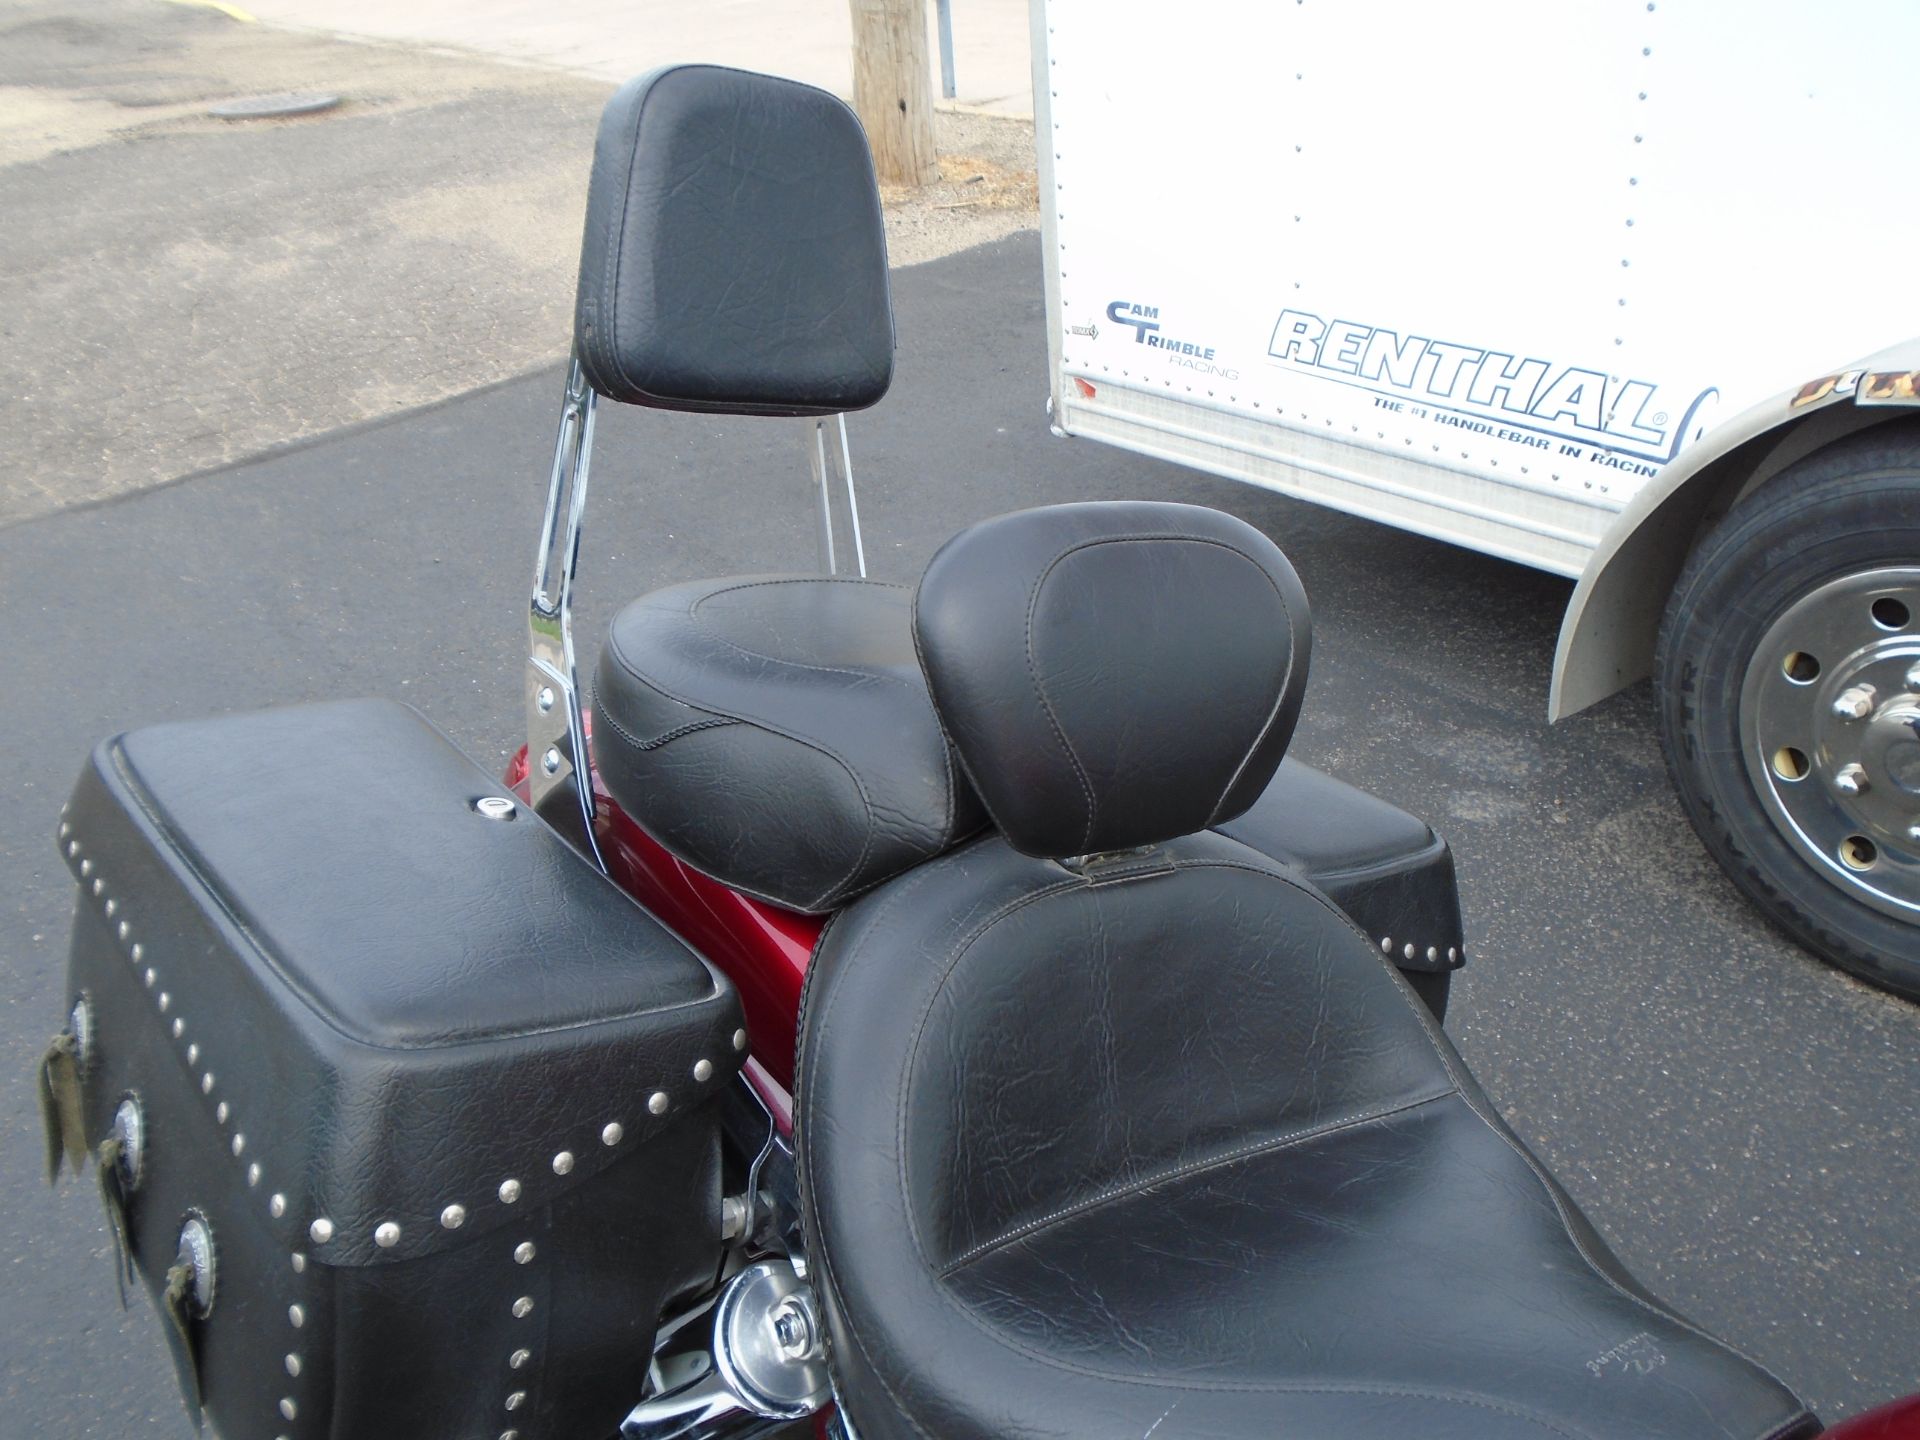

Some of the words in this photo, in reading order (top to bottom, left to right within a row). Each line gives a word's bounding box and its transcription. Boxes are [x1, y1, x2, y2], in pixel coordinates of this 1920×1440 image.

[1106, 301, 1158, 325] CAM
[1133, 319, 1216, 361] TRIMBLE
[1168, 354, 1240, 381] RACING
[1268, 308, 1666, 446] RENTHAL
[1374, 396, 1404, 413] THE
[1411, 406, 1428, 419] #1
[1434, 412, 1551, 450] HANDLEBAR
[1559, 443, 1582, 457] IN
[1590, 452, 1658, 478] RACIN
